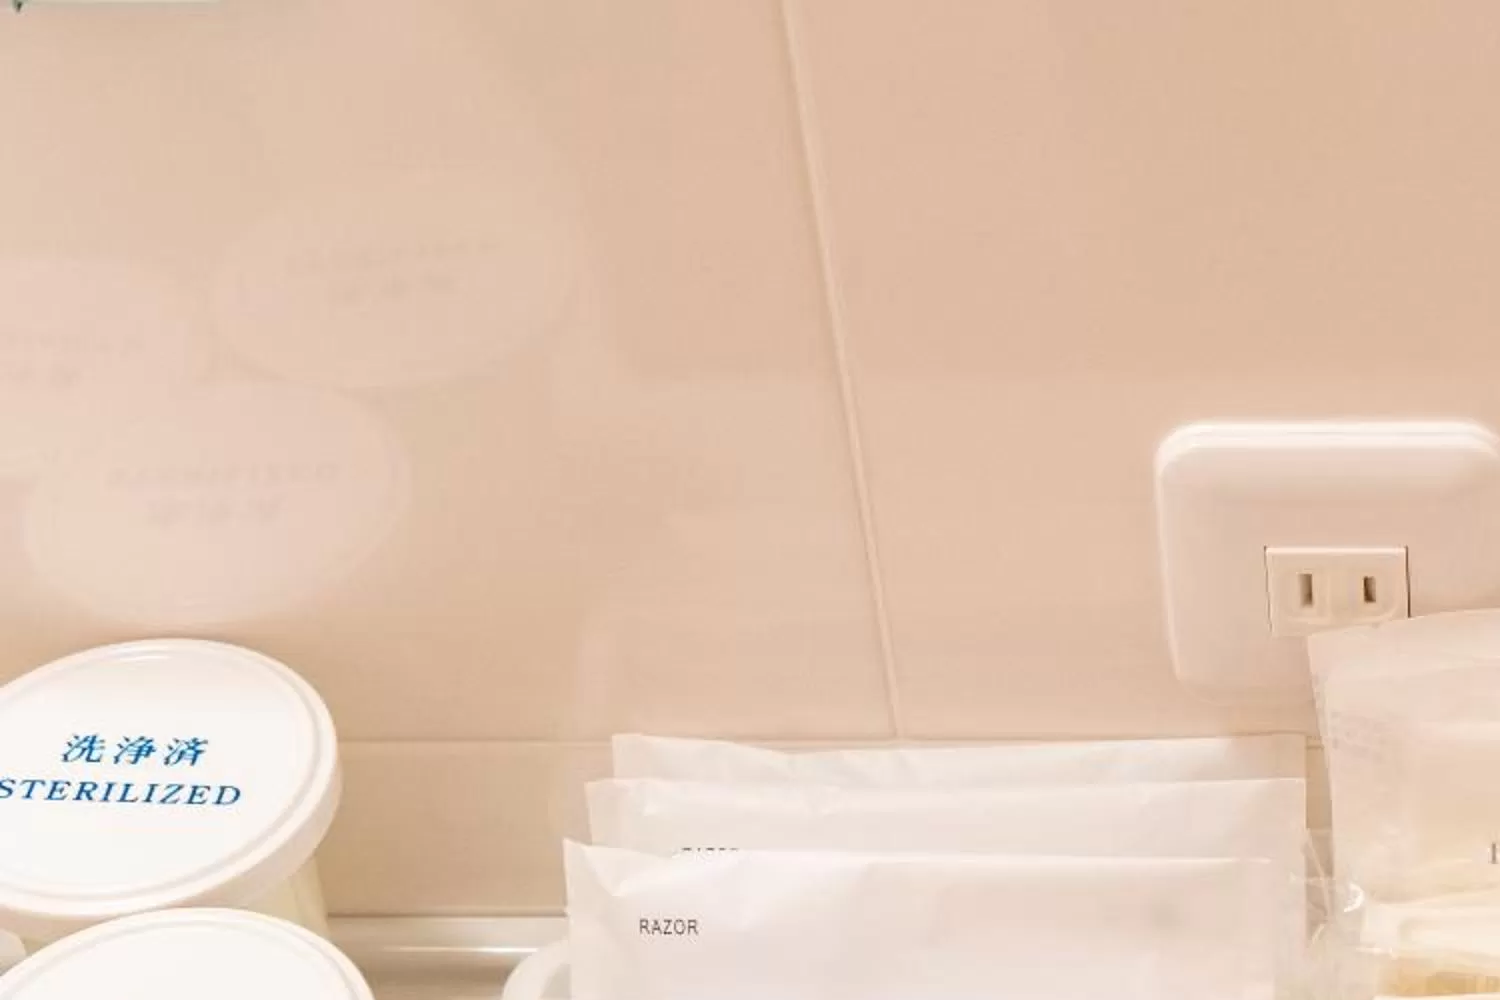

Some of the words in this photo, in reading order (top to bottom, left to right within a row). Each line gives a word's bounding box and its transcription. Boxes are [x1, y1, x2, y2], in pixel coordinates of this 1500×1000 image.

[61, 734, 208, 766] 洗浄済
[0, 777, 241, 805] STERILIZED
[639, 918, 699, 935] RAZOR
